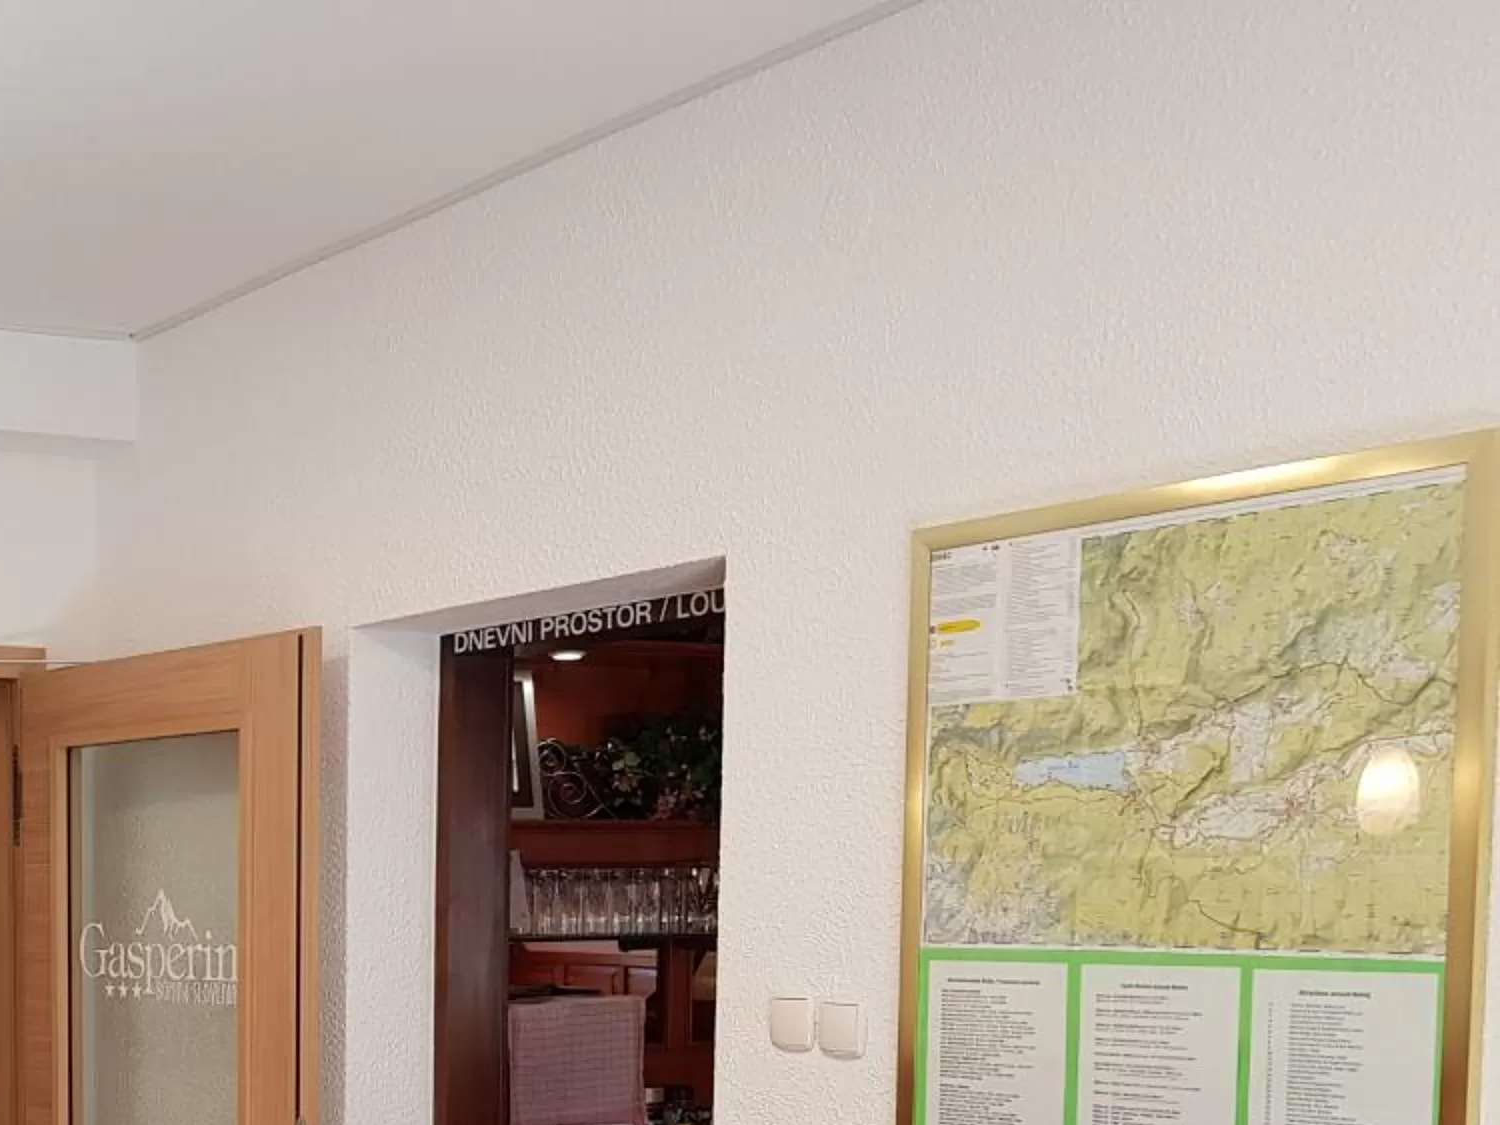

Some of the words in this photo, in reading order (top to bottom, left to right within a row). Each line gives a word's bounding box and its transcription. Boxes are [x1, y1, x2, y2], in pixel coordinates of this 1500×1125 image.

[453, 621, 534, 654] DNEVNI
[539, 601, 653, 641] PROSTOR
[658, 596, 669, 622] /
[79, 922, 238, 995] Gasperin
